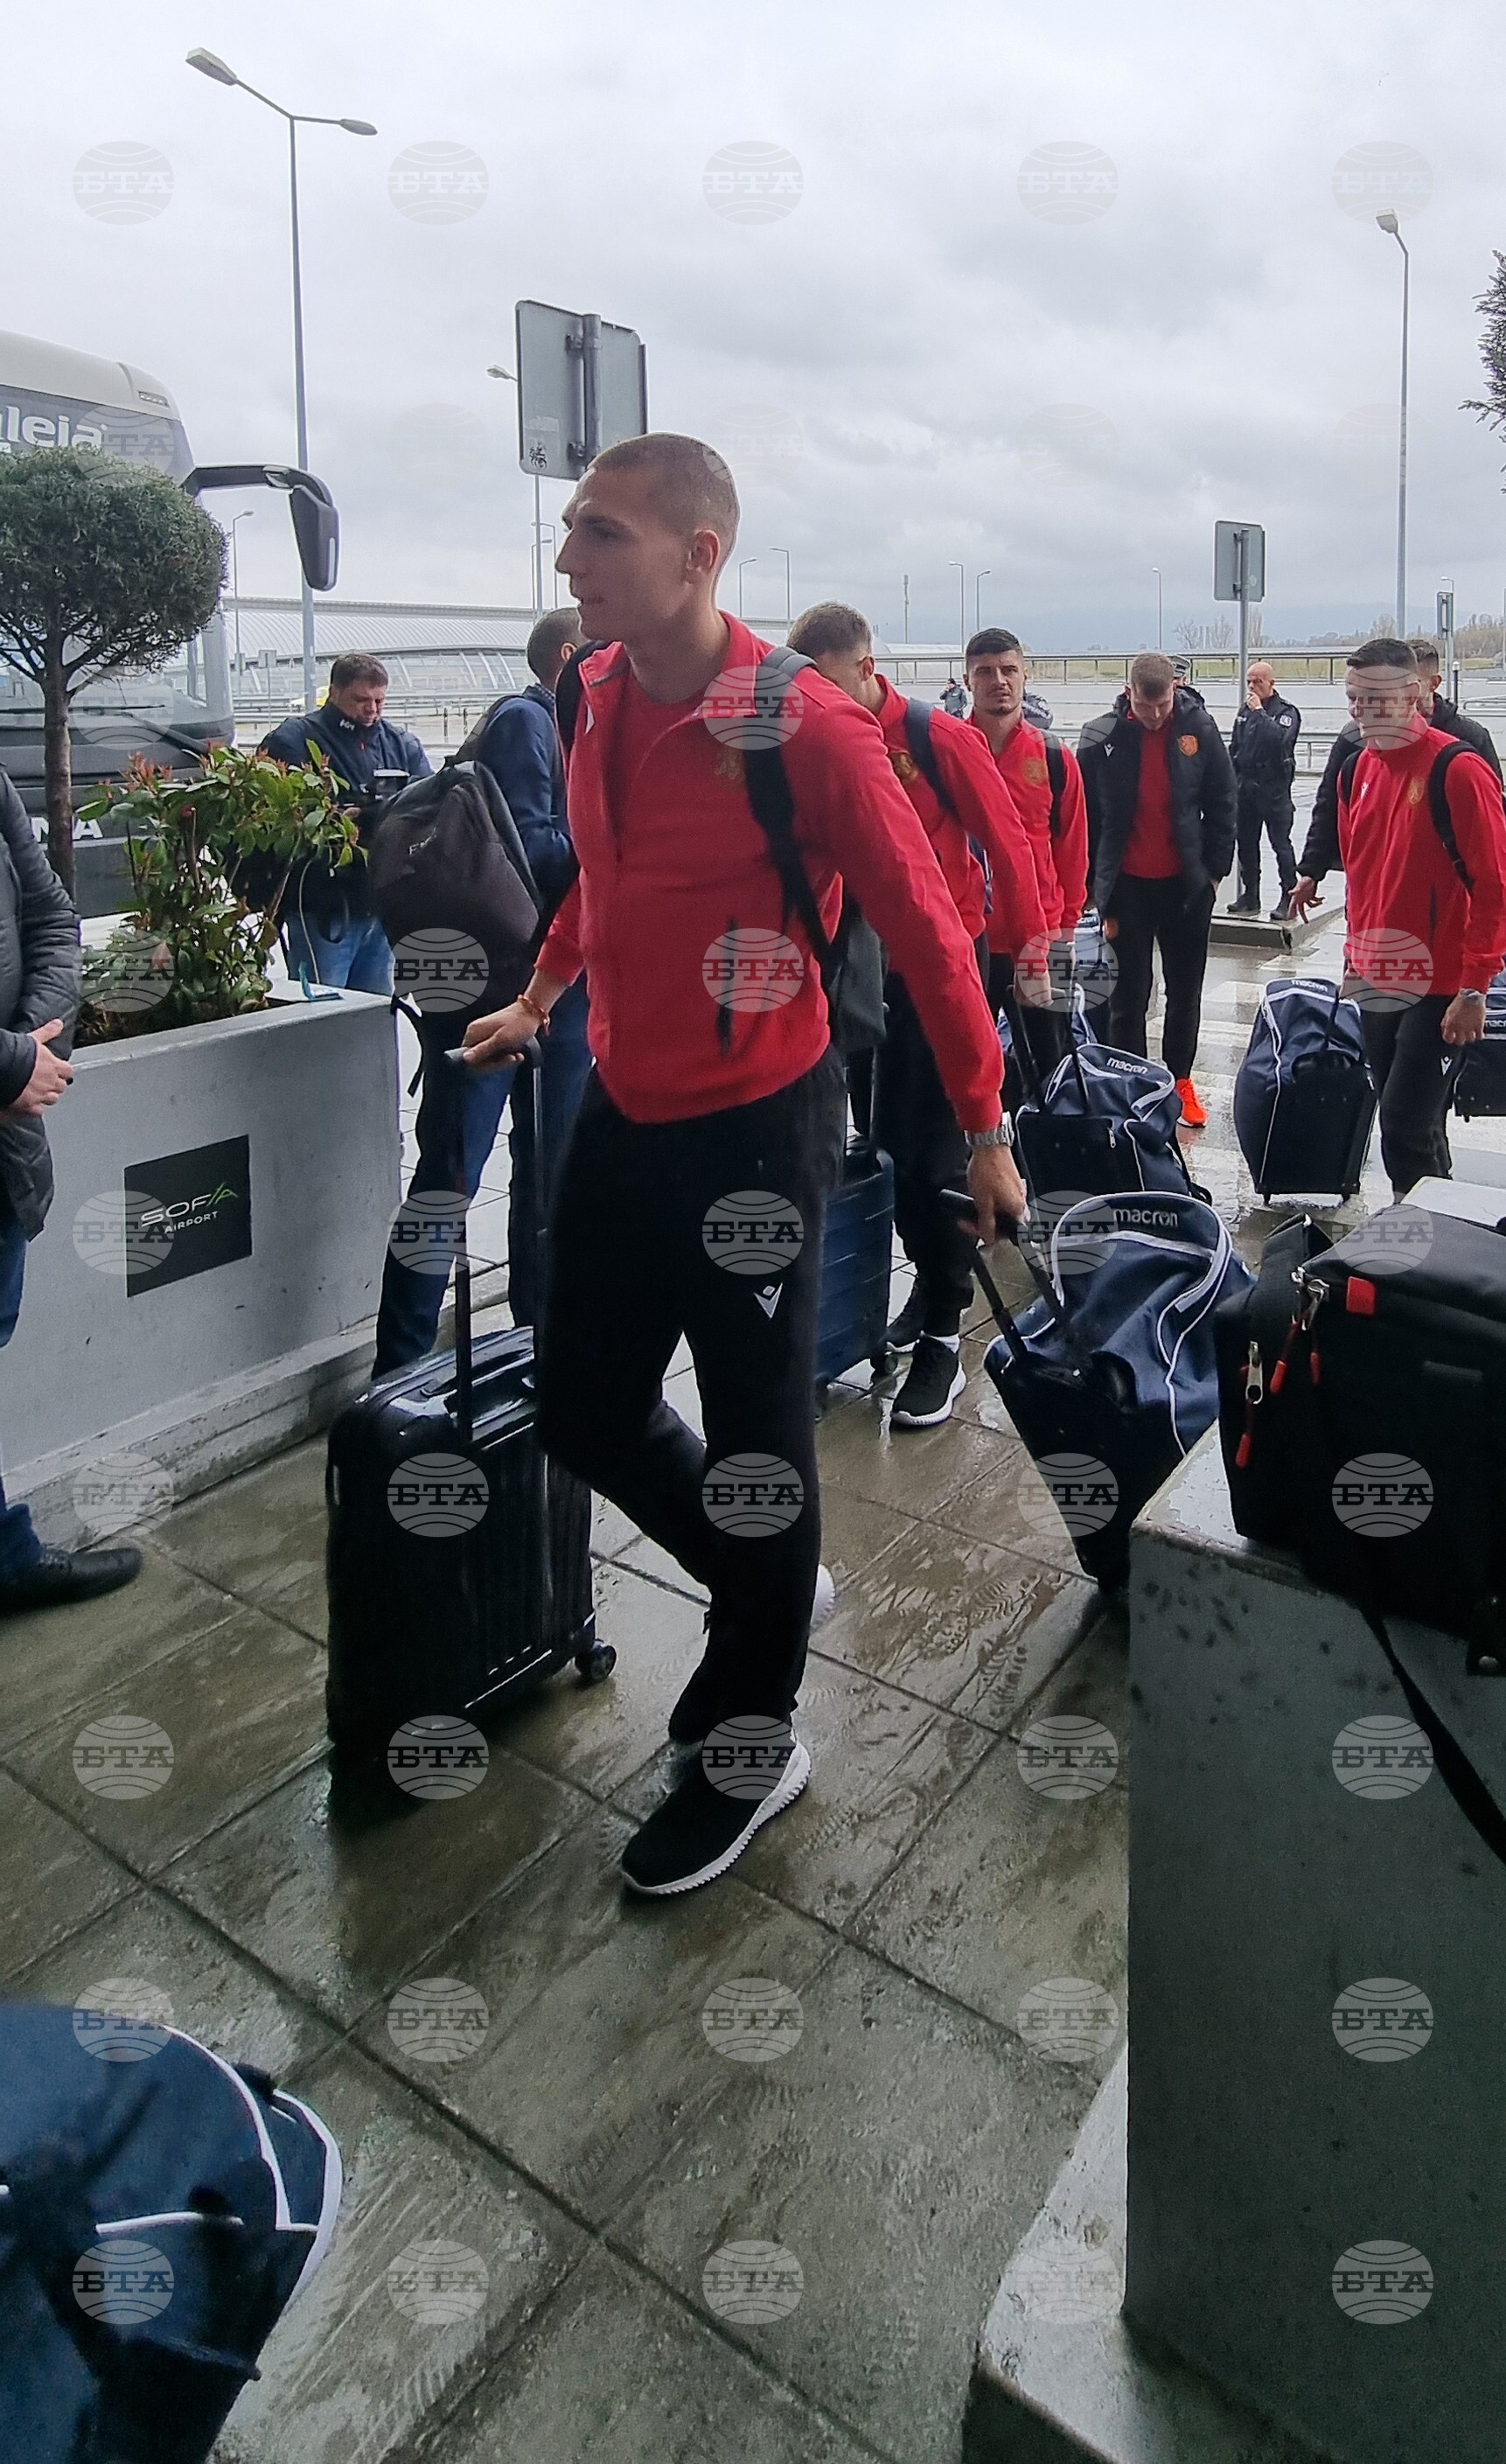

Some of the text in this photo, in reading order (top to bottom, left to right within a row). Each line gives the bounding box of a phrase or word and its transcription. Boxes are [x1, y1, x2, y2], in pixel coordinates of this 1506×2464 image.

[0, 405, 104, 452] leia
[1291, 980, 1328, 993] macron
[1106, 1057, 1148, 1075] macron
[141, 1183, 239, 1227] SOFIA
[164, 1211, 219, 1235] AIRPORT
[1112, 1209, 1178, 1227] macron
